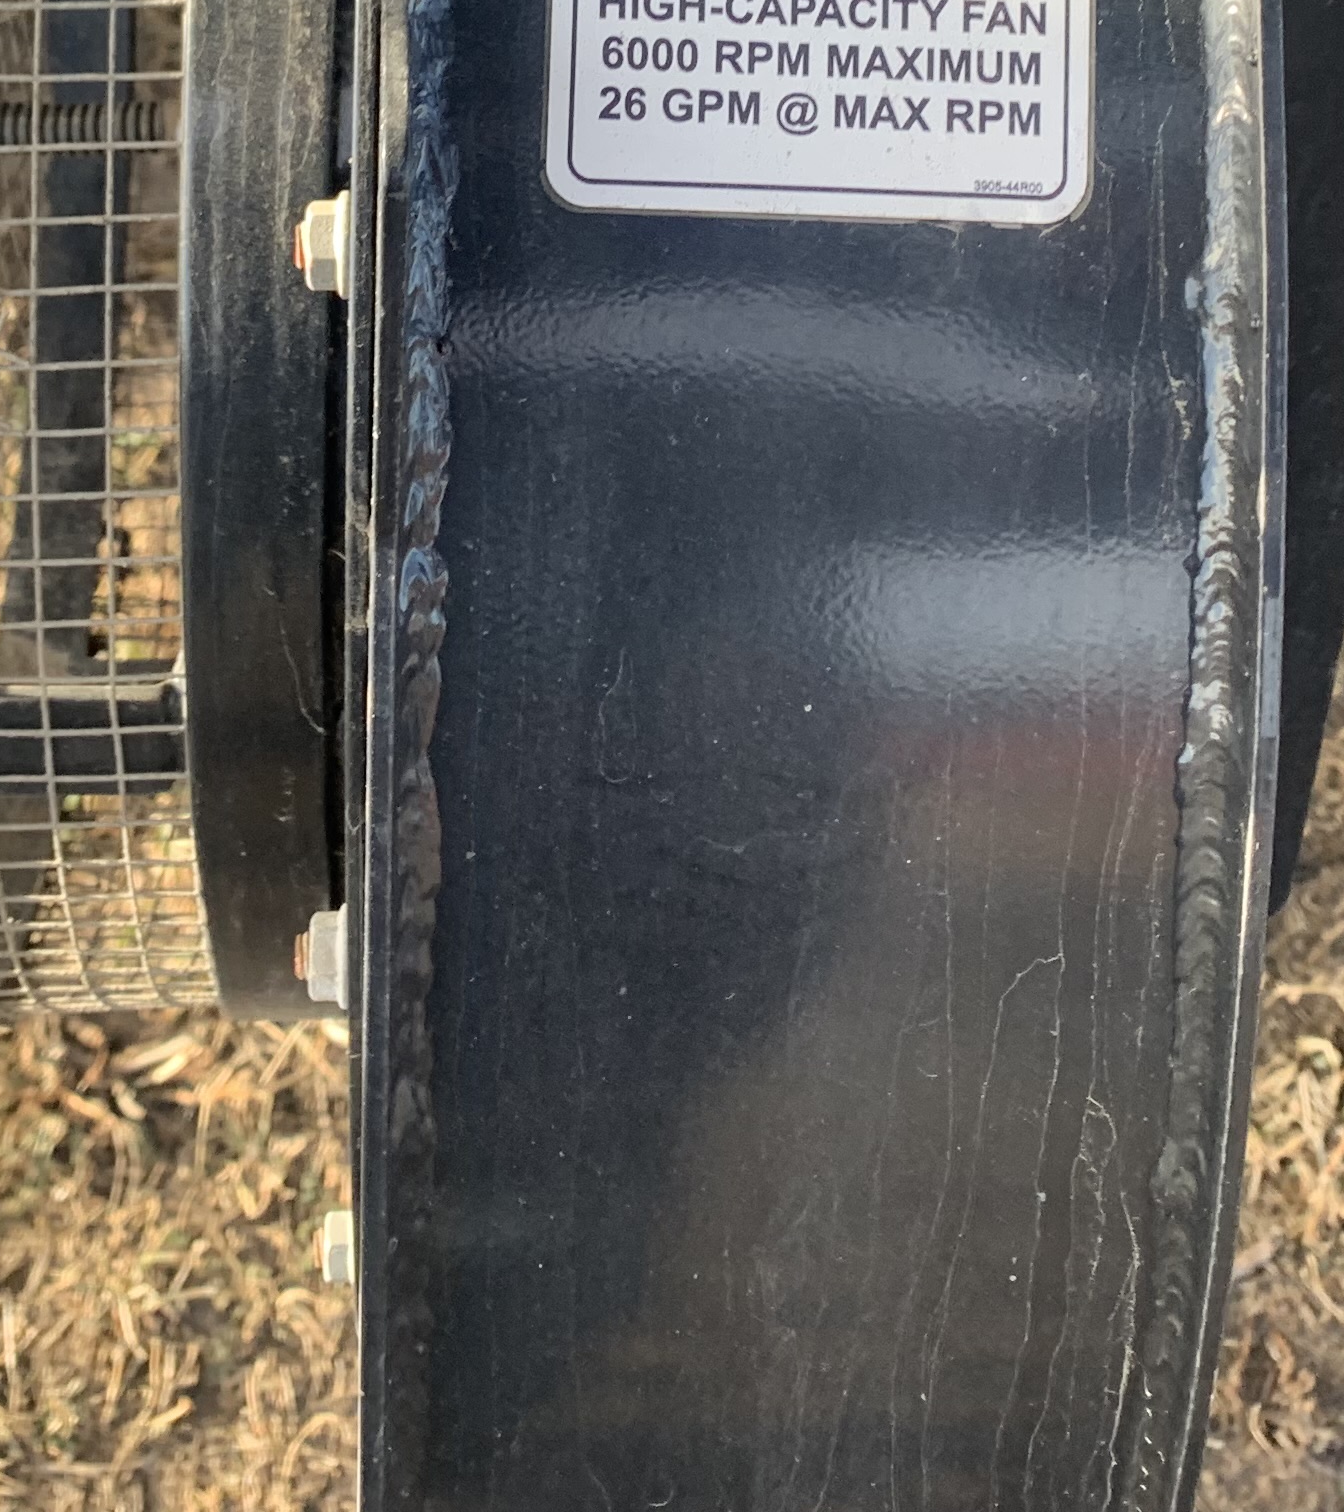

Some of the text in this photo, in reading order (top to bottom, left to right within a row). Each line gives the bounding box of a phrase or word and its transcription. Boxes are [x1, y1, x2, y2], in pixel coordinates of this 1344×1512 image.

[961, 0, 1047, 36] FAN
[601, 36, 1042, 86] 6000 RPM MAXIMUM
[598, 86, 1042, 137] 26 GPM @ MAX RPM
